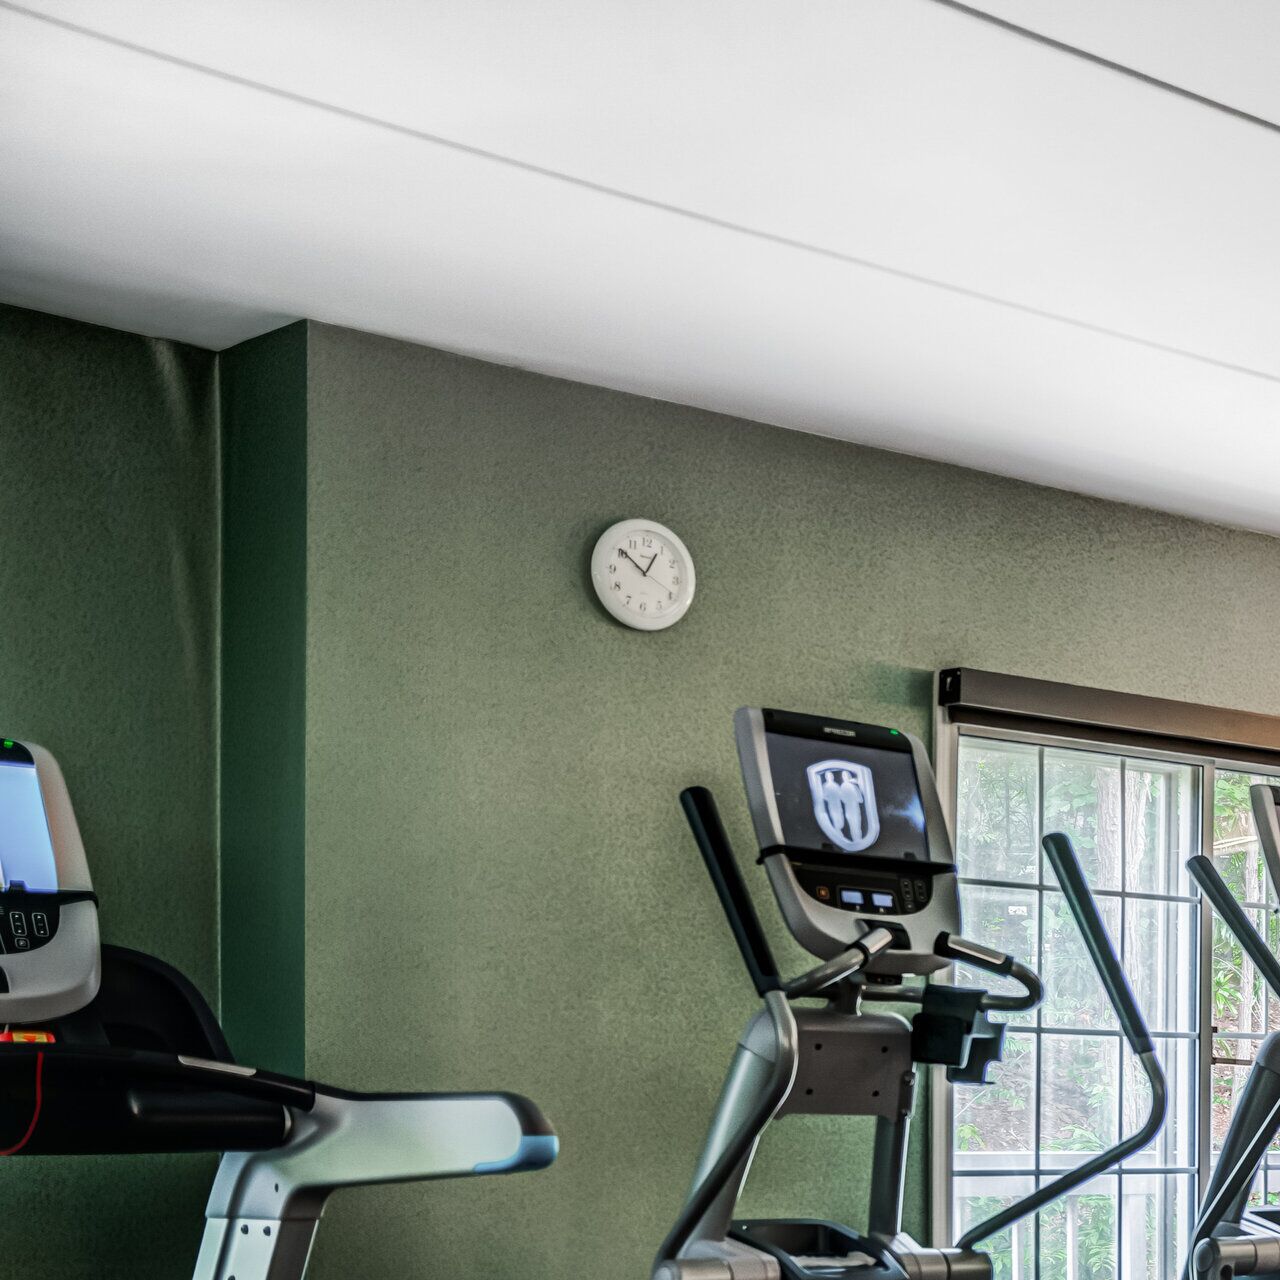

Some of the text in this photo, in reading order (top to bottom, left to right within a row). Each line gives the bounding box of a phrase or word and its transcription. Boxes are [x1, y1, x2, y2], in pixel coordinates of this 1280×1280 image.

[643, 537, 653, 548] 12
[608, 564, 617, 575] 9
[613, 581, 621, 591] 8
[626, 595, 632, 605] 7
[639, 601, 647, 612] 6
